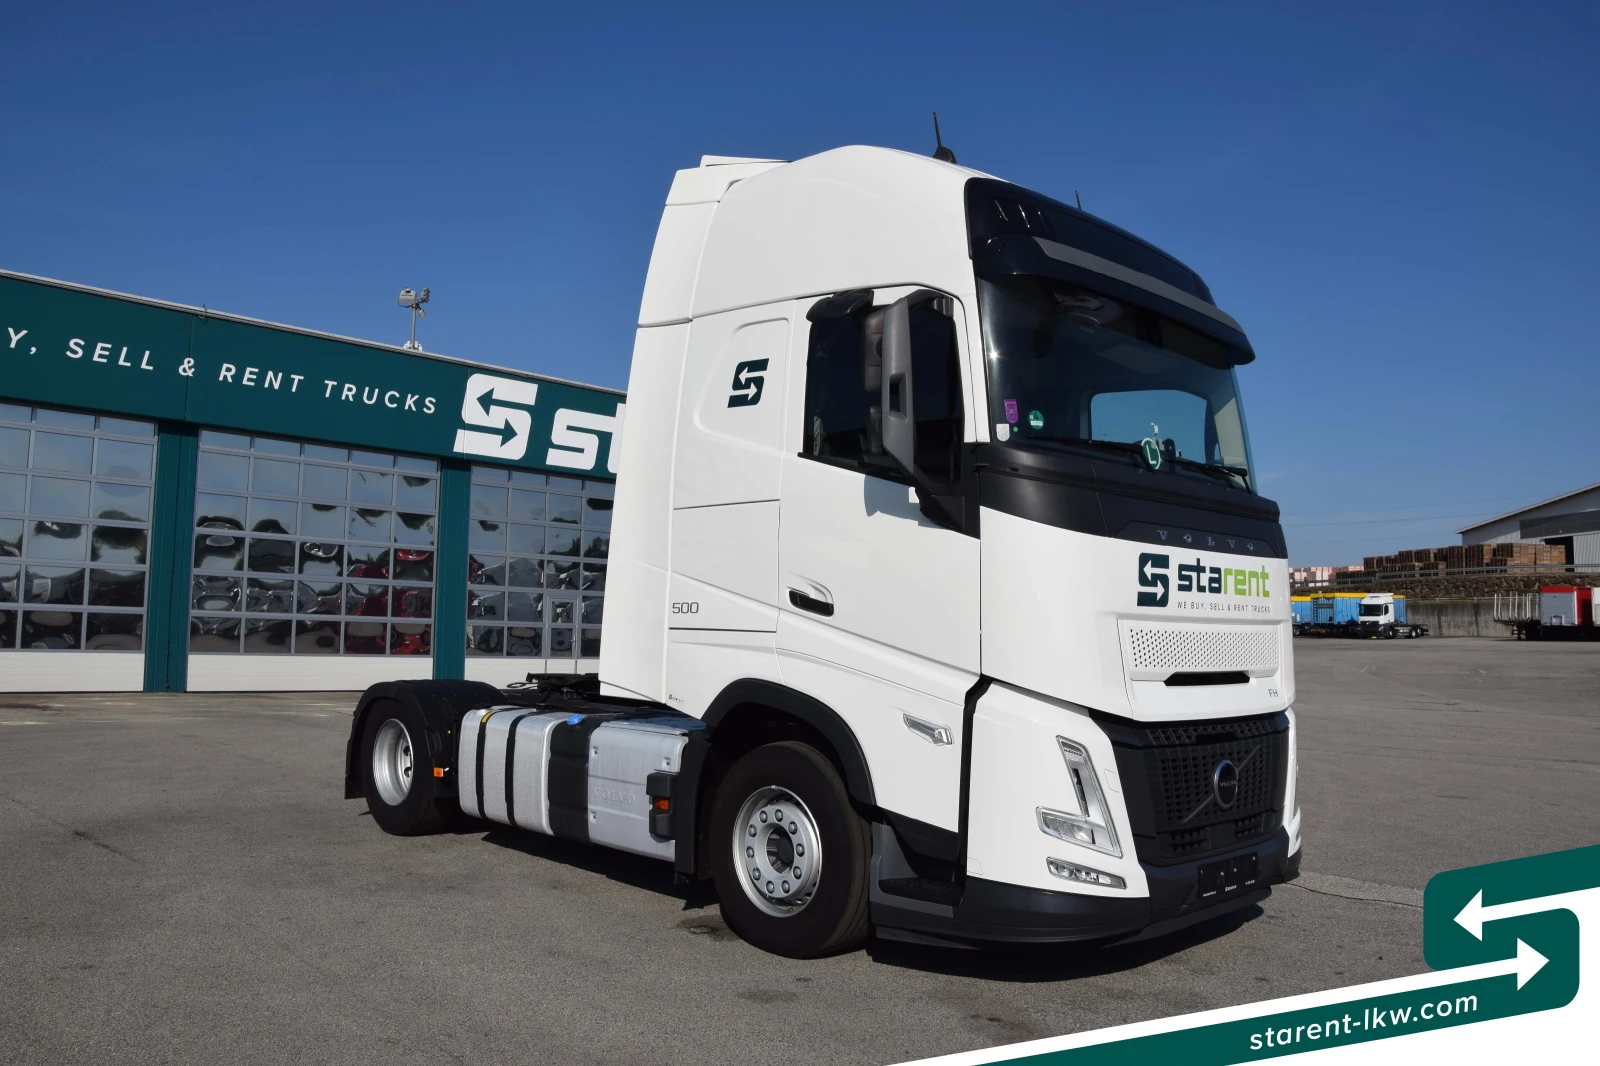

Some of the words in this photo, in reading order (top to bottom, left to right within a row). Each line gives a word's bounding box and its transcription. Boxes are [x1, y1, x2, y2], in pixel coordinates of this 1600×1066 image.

[66, 338, 154, 371] SELL
[178, 357, 196, 377] &
[218, 363, 304, 393] RENT
[323, 380, 437, 414] TRUCKS
[1157, 530, 1254, 550] VOLVO
[1177, 558, 1270, 597] starent
[672, 602, 699, 614] 500
[1177, 601, 1187, 609] WE
[1209, 602, 1224, 611] SELL
[1227, 603, 1231, 611] &
[1233, 604, 1248, 612] RENT
[1250, 605, 1271, 613] TRUCKS
[1268, 689, 1279, 698] FH
[591, 786, 636, 805] VOLVO
